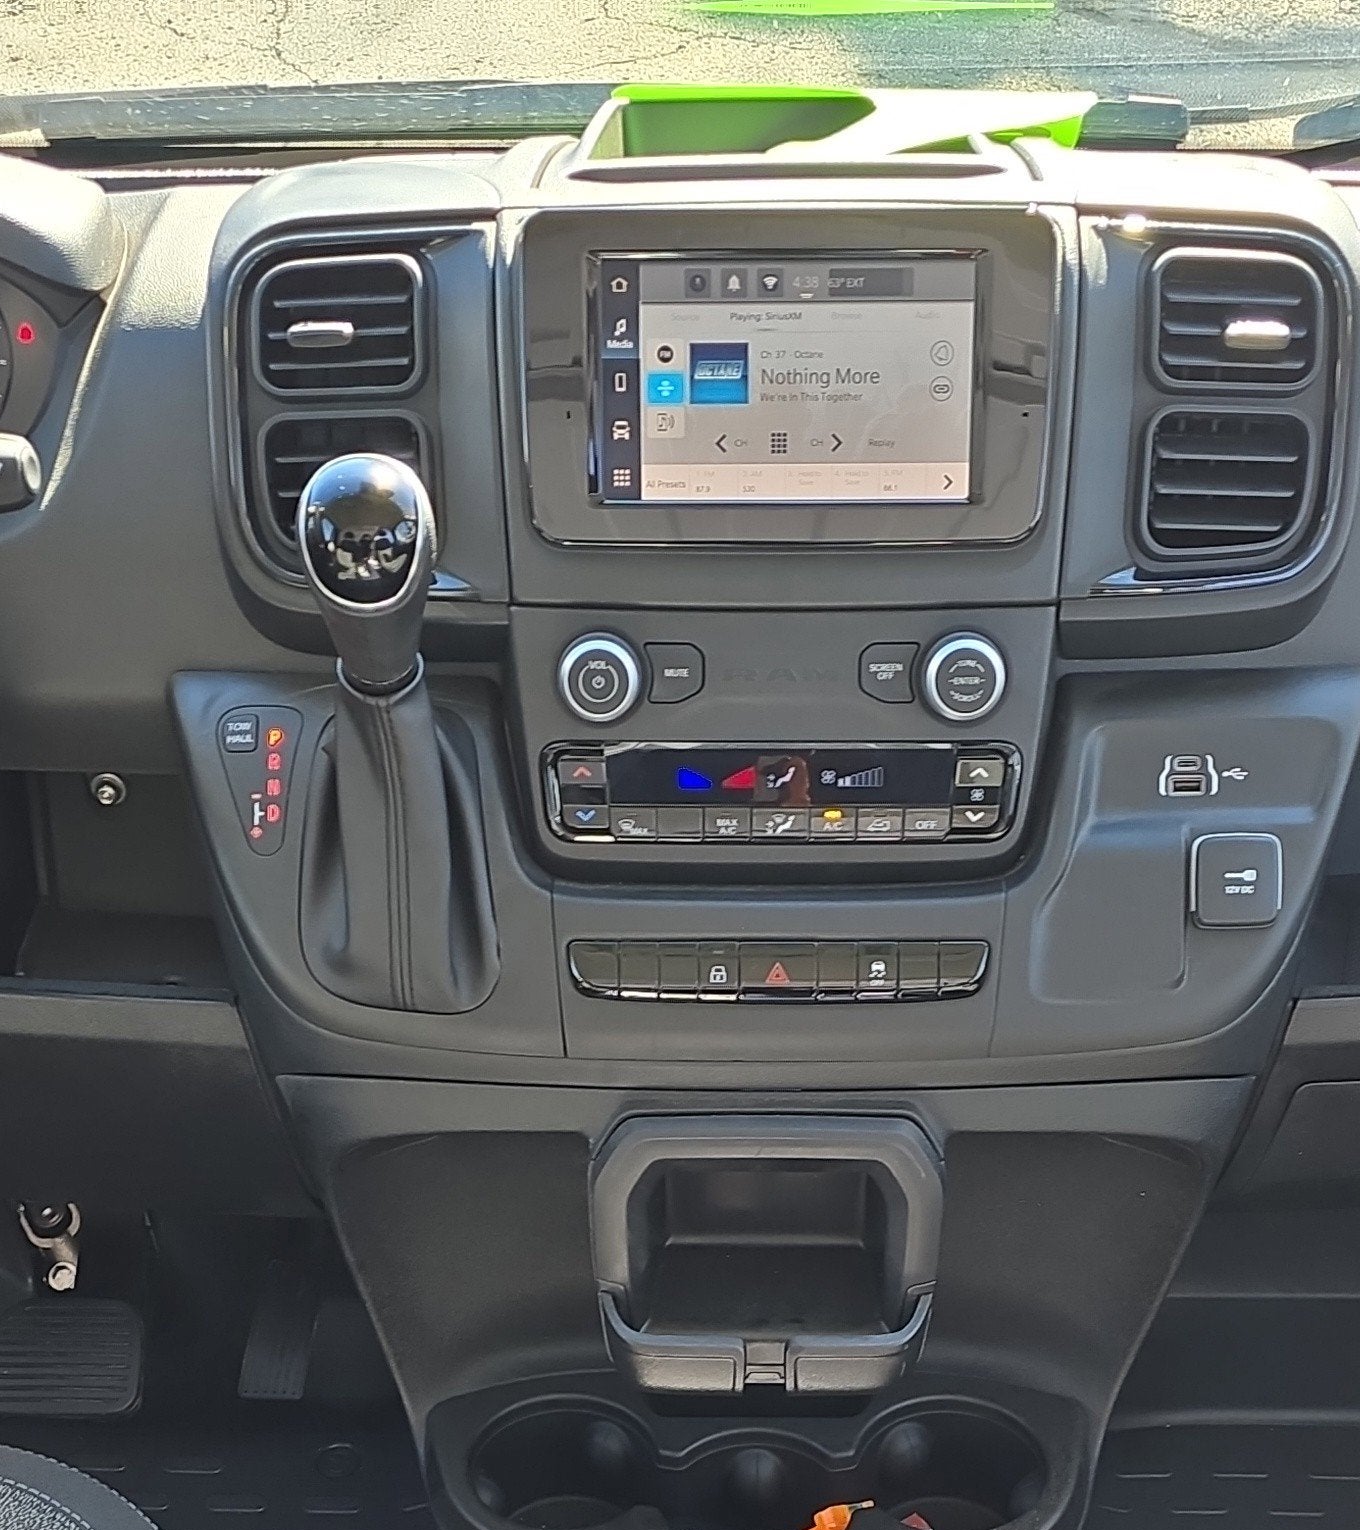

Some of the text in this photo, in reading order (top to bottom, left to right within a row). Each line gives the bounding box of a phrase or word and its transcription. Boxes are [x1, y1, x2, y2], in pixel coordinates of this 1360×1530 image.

[730, 311, 803, 322] Playing: SiriusXM
[761, 367, 881, 388] Nothing More
[588, 661, 607, 669] VOL
[868, 663, 904, 672] SCREEN
[664, 668, 690, 677] MUTE
[876, 672, 895, 680] OFF
[953, 676, 981, 685] ENTER
[227, 722, 253, 731] TOW
[225, 734, 254, 744] HAUL
[268, 728, 283, 746] P
[266, 804, 280, 822] D
[716, 819, 738, 827] MAX
[823, 822, 843, 831] A/C
[915, 820, 938, 829] OFF
